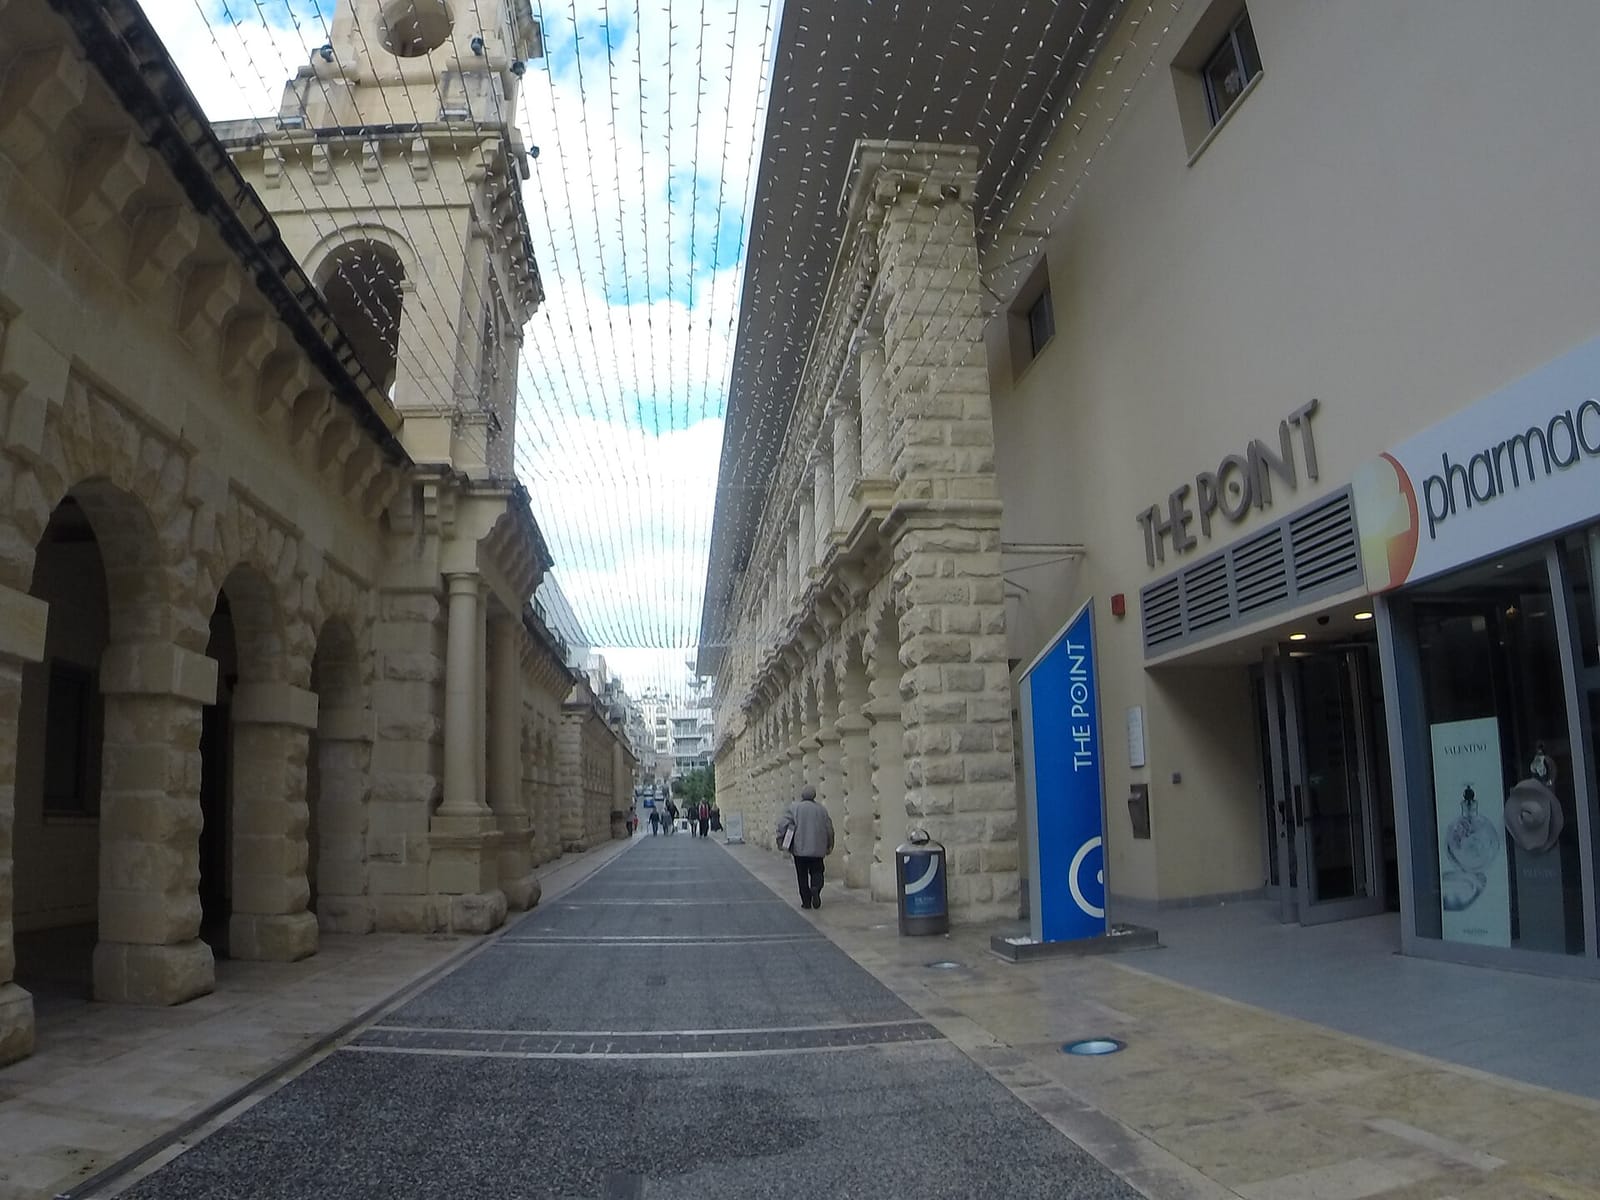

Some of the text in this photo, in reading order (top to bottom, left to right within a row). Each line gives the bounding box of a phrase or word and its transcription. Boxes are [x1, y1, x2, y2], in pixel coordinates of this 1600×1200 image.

[1136, 398, 1319, 568] THE POINT
[1423, 399, 1600, 539] pharmac
[1067, 640, 1092, 772] THE POINT
[1443, 743, 1487, 755] VALENTINO
